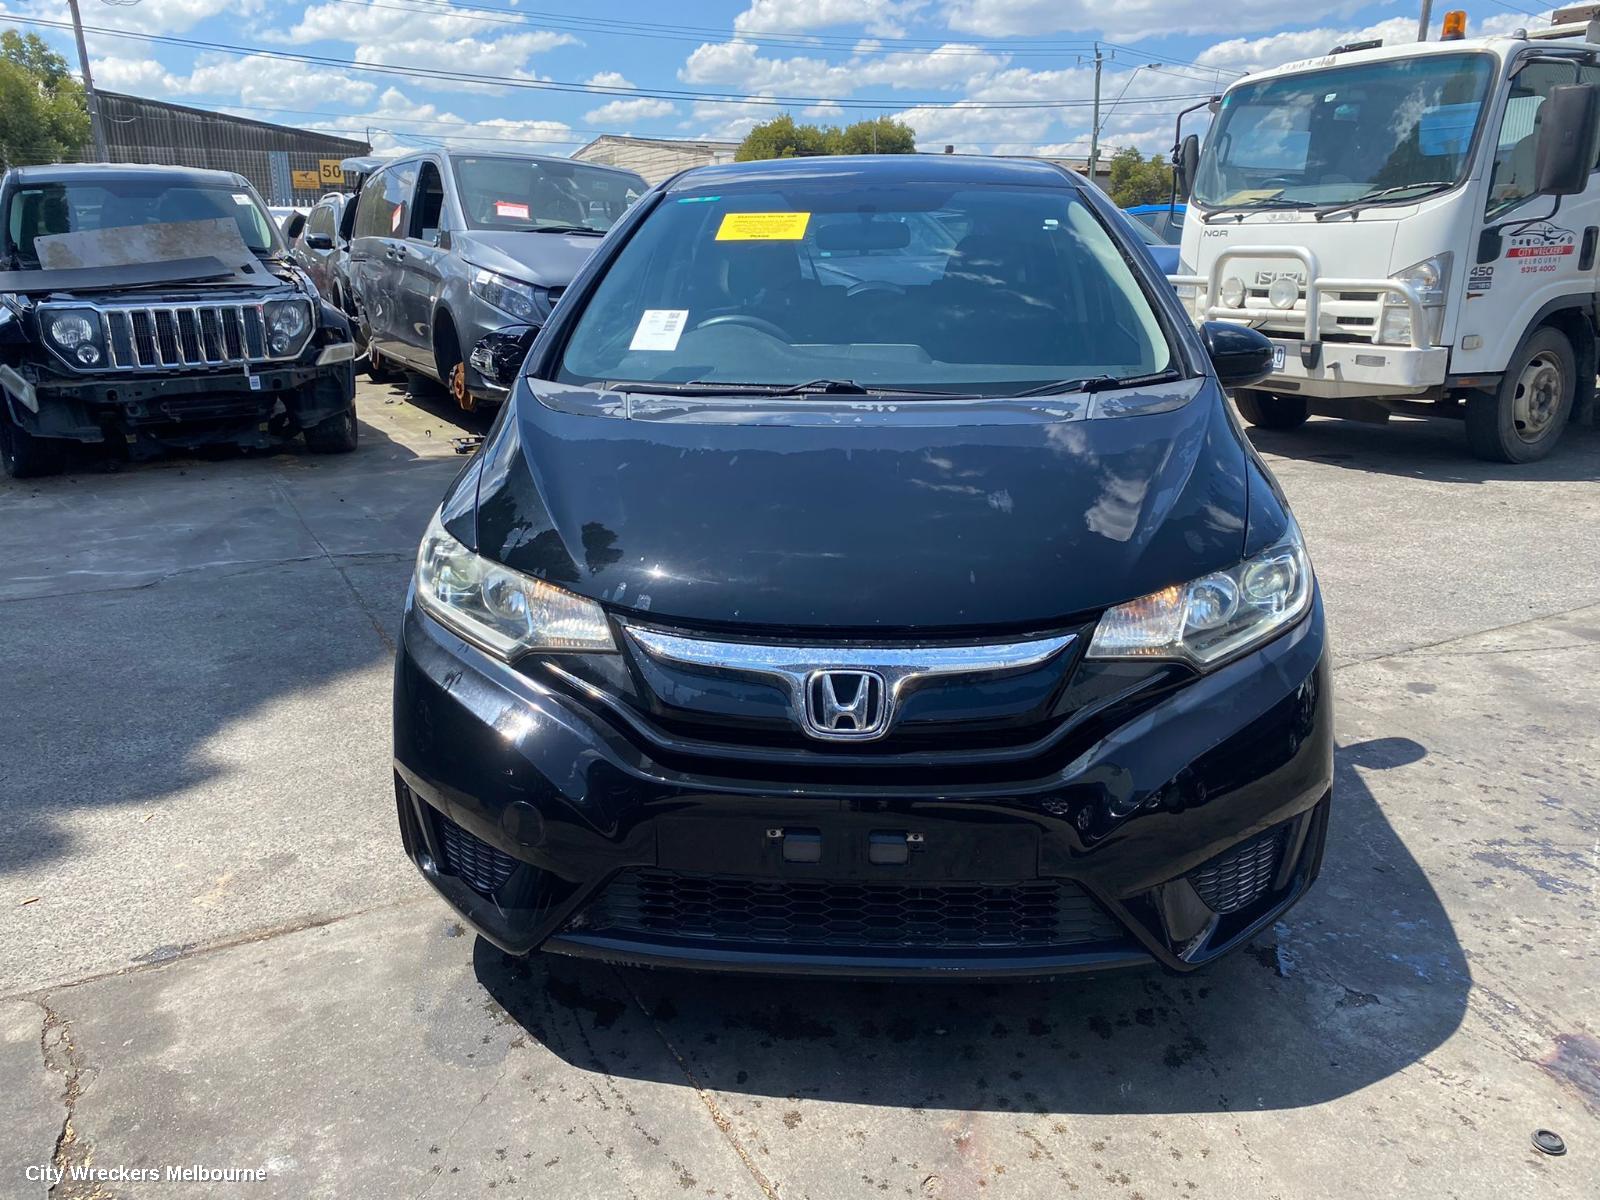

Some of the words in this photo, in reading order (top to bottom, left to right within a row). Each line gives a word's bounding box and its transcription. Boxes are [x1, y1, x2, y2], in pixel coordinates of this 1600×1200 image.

[323, 165, 341, 178] 50
[1203, 230, 1229, 238] NQR
[1518, 248, 1533, 257] CITY
[1534, 246, 1564, 255] WRECKERS
[1518, 256, 1562, 265] MELBOURNE
[1470, 266, 1494, 276] 450
